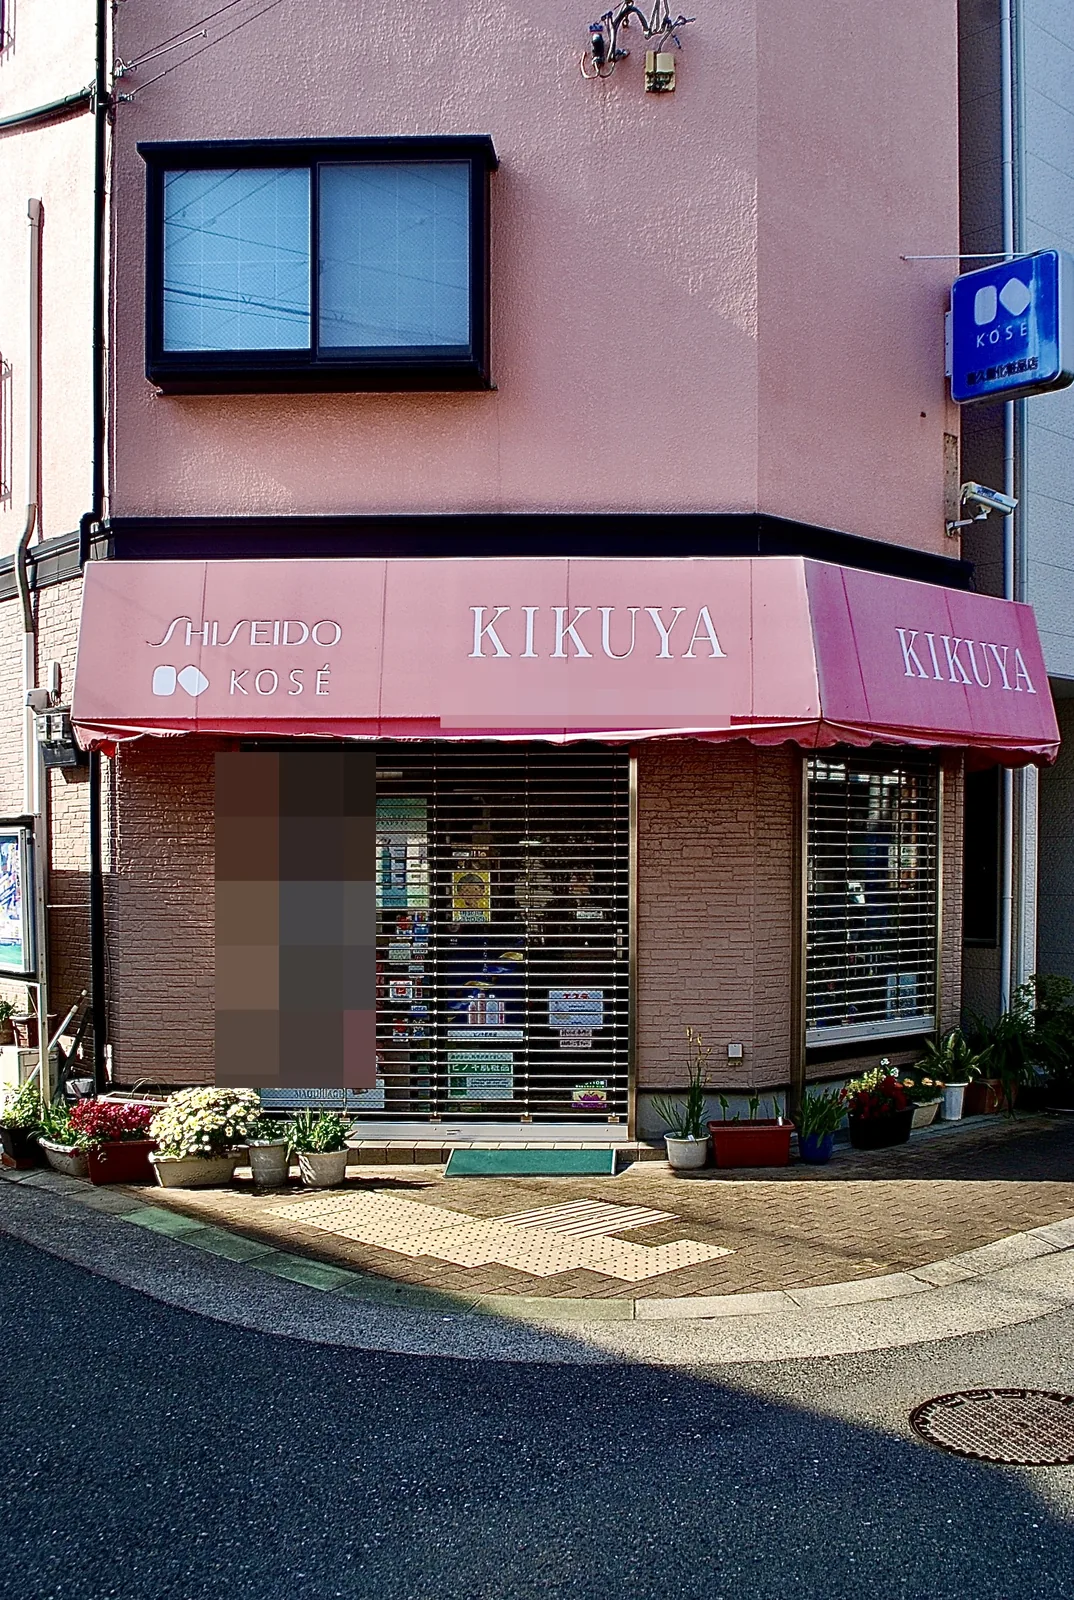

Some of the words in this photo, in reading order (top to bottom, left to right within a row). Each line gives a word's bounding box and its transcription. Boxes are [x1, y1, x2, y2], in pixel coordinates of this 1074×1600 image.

[146, 615, 343, 647] SHISEIDO
[468, 605, 727, 660] KIKUYA
[229, 664, 331, 695] KOSÉ
[895, 626, 1037, 694] KIKUYA
